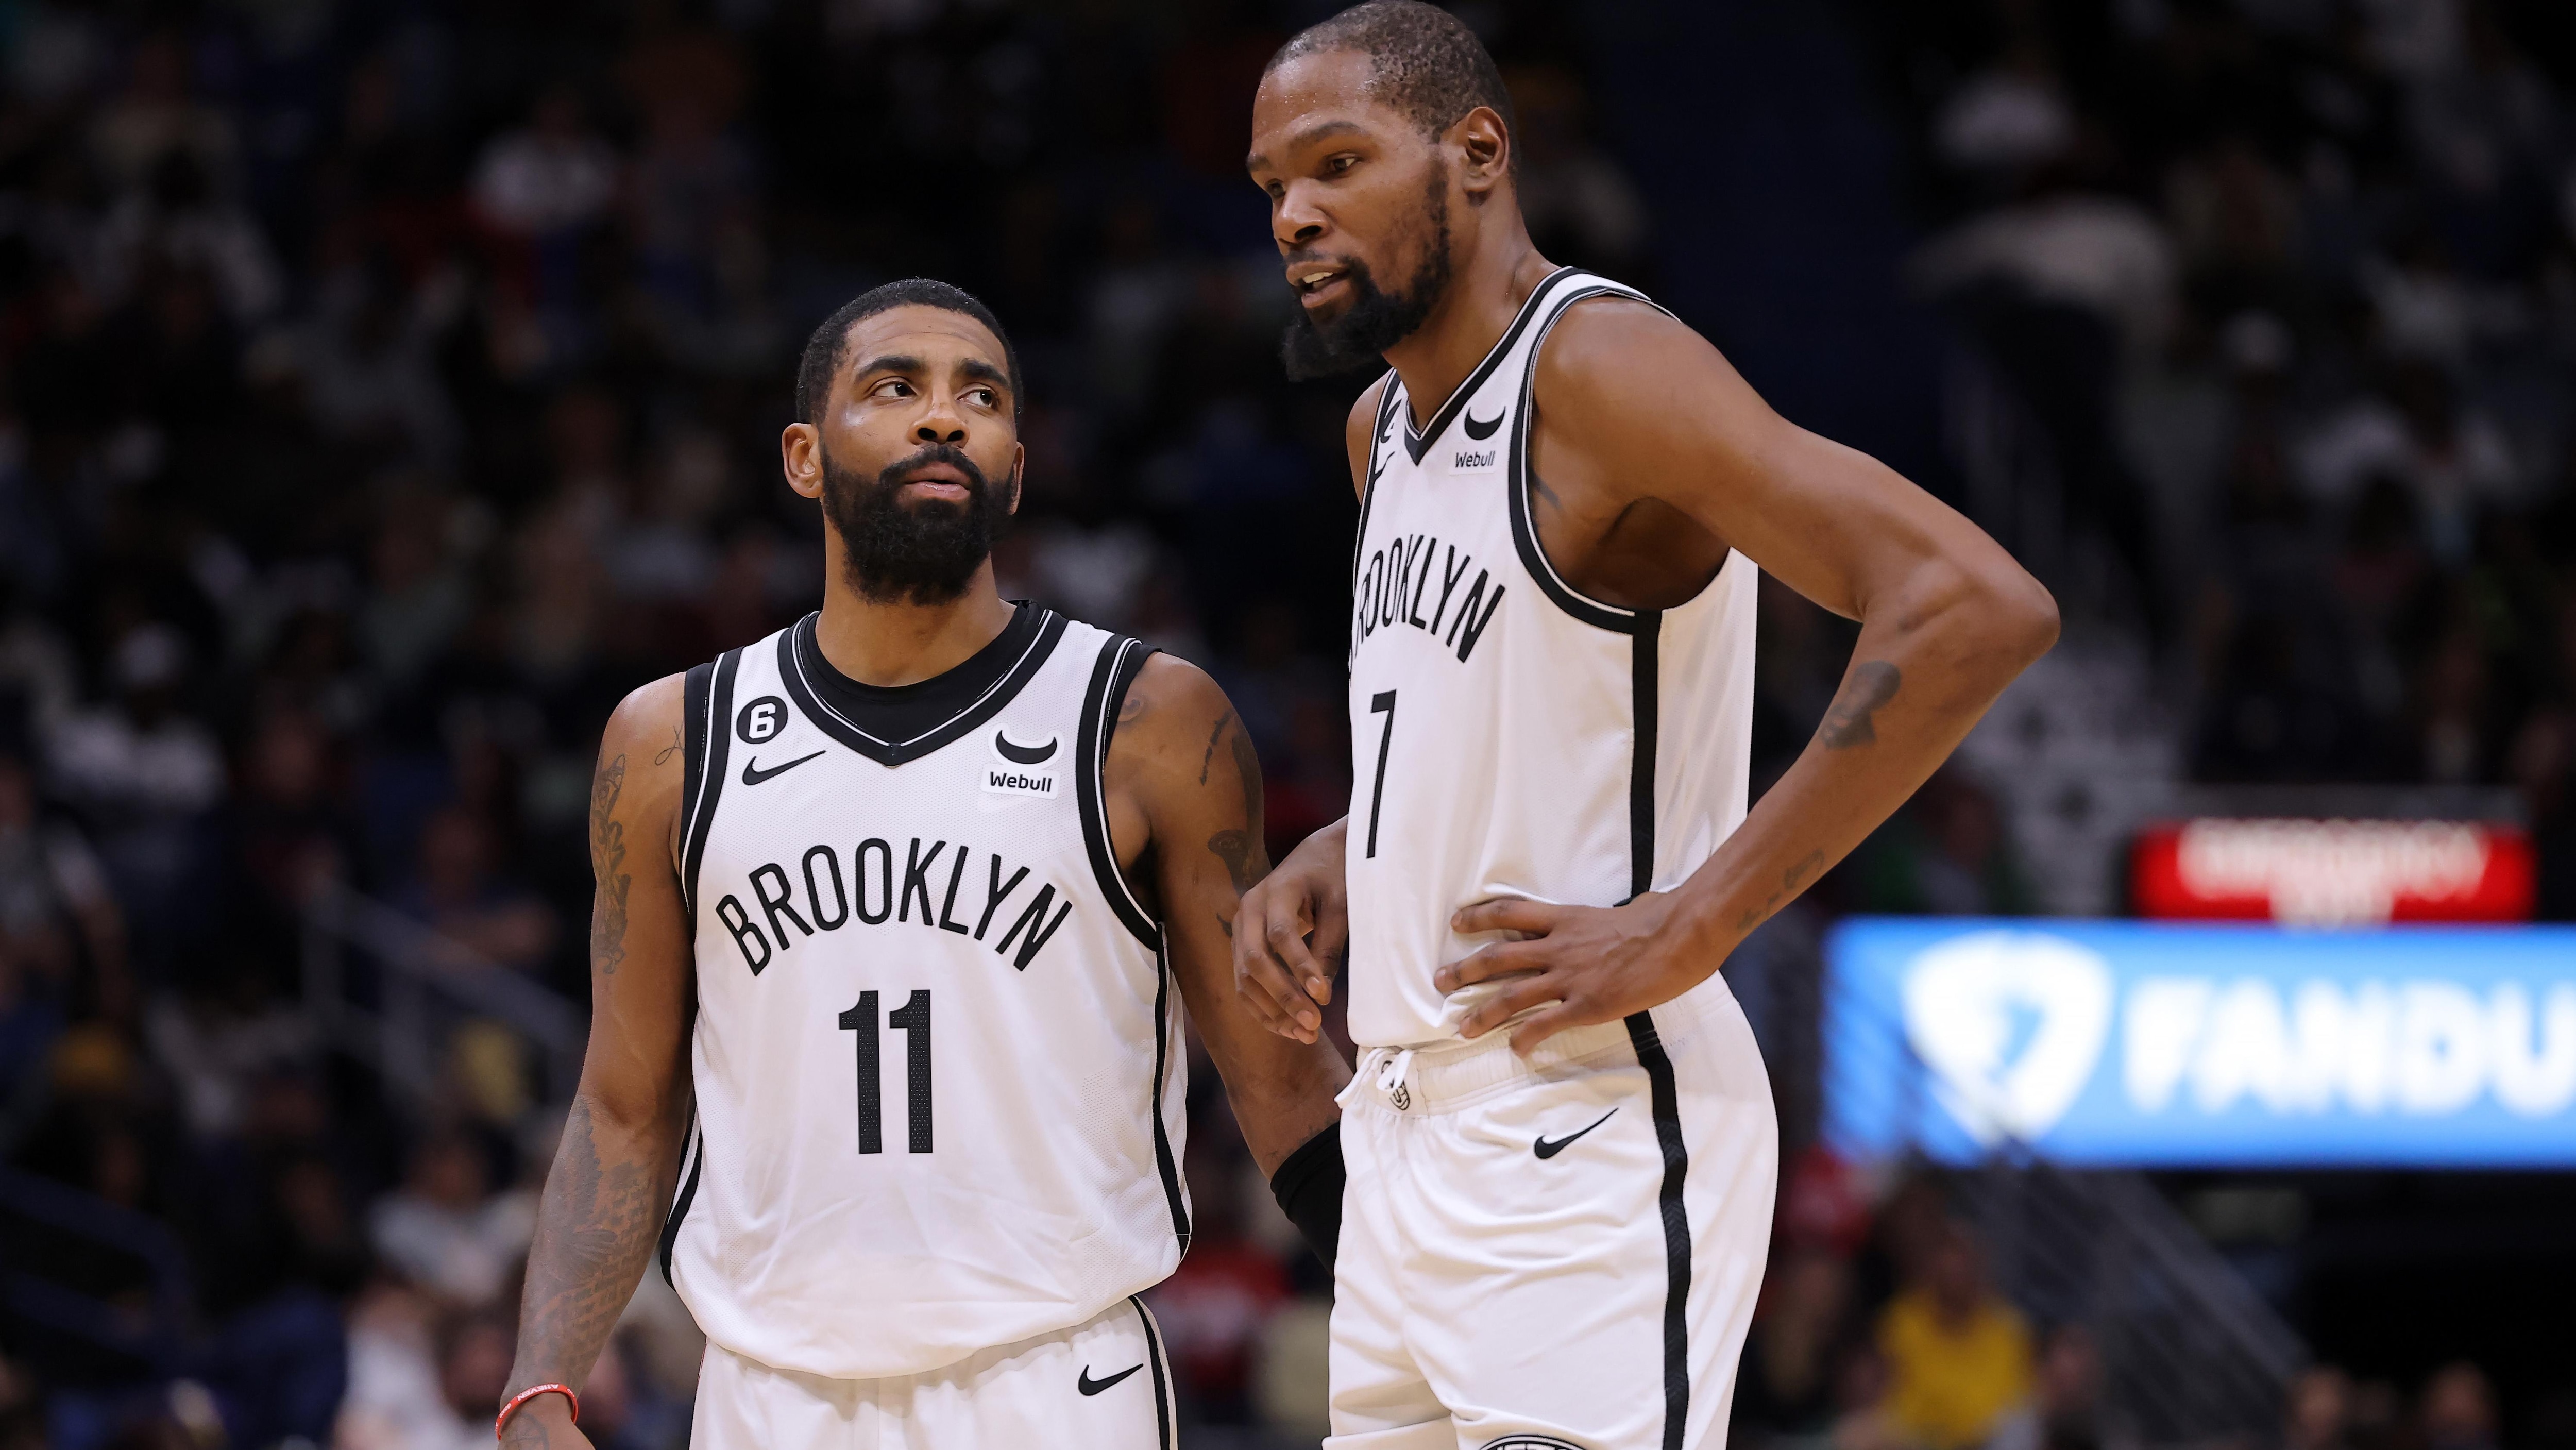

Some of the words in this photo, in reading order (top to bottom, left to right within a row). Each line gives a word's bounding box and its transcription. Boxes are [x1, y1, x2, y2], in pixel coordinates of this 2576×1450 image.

[1454, 450, 1496, 469] Webull
[749, 703, 776, 739] 6
[989, 771, 1052, 793] Webull
[1366, 689, 1397, 859] 7
[715, 837, 1073, 976] BROOKLYN
[839, 989, 933, 1154] 11
